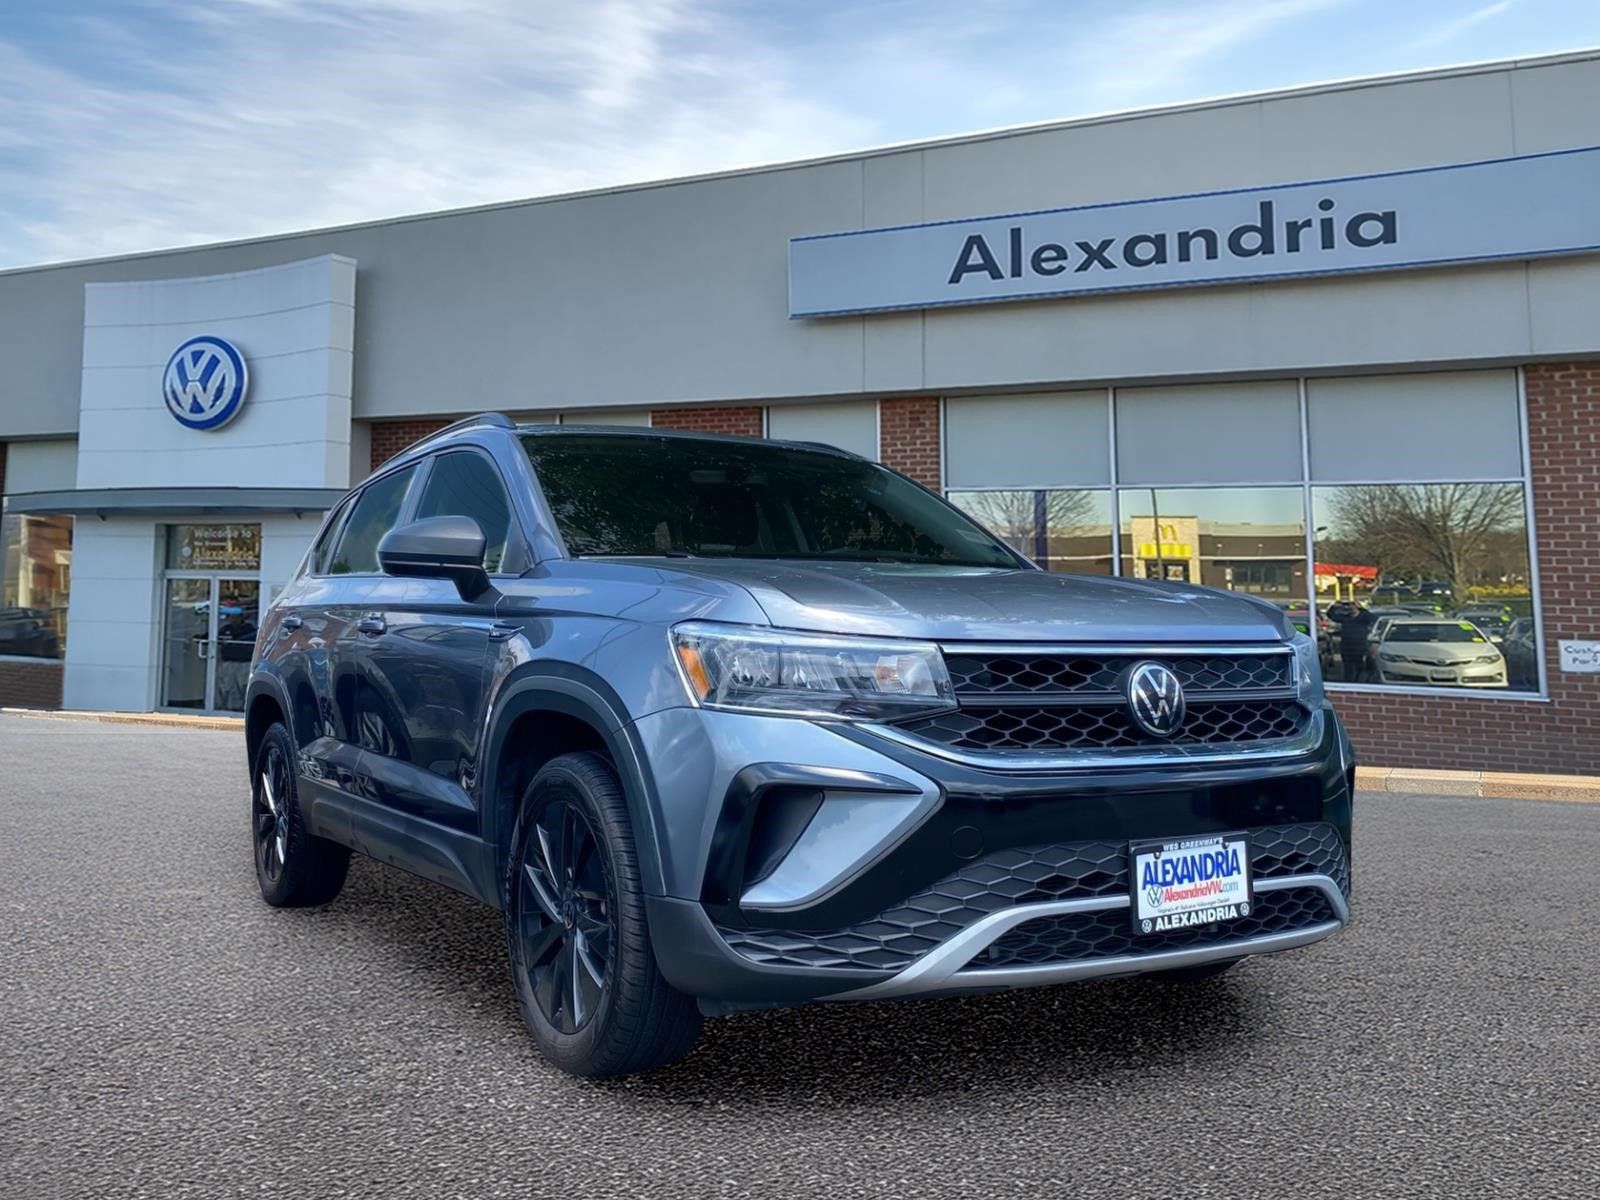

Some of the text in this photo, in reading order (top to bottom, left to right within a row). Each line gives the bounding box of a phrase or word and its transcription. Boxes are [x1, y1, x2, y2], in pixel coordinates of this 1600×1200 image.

[948, 199, 1397, 285] Alexandria
[194, 529, 240, 538] Welcome
[1142, 848, 1242, 891] ALEXANDRIA
[1155, 904, 1238, 932] ALEXANDRIA
